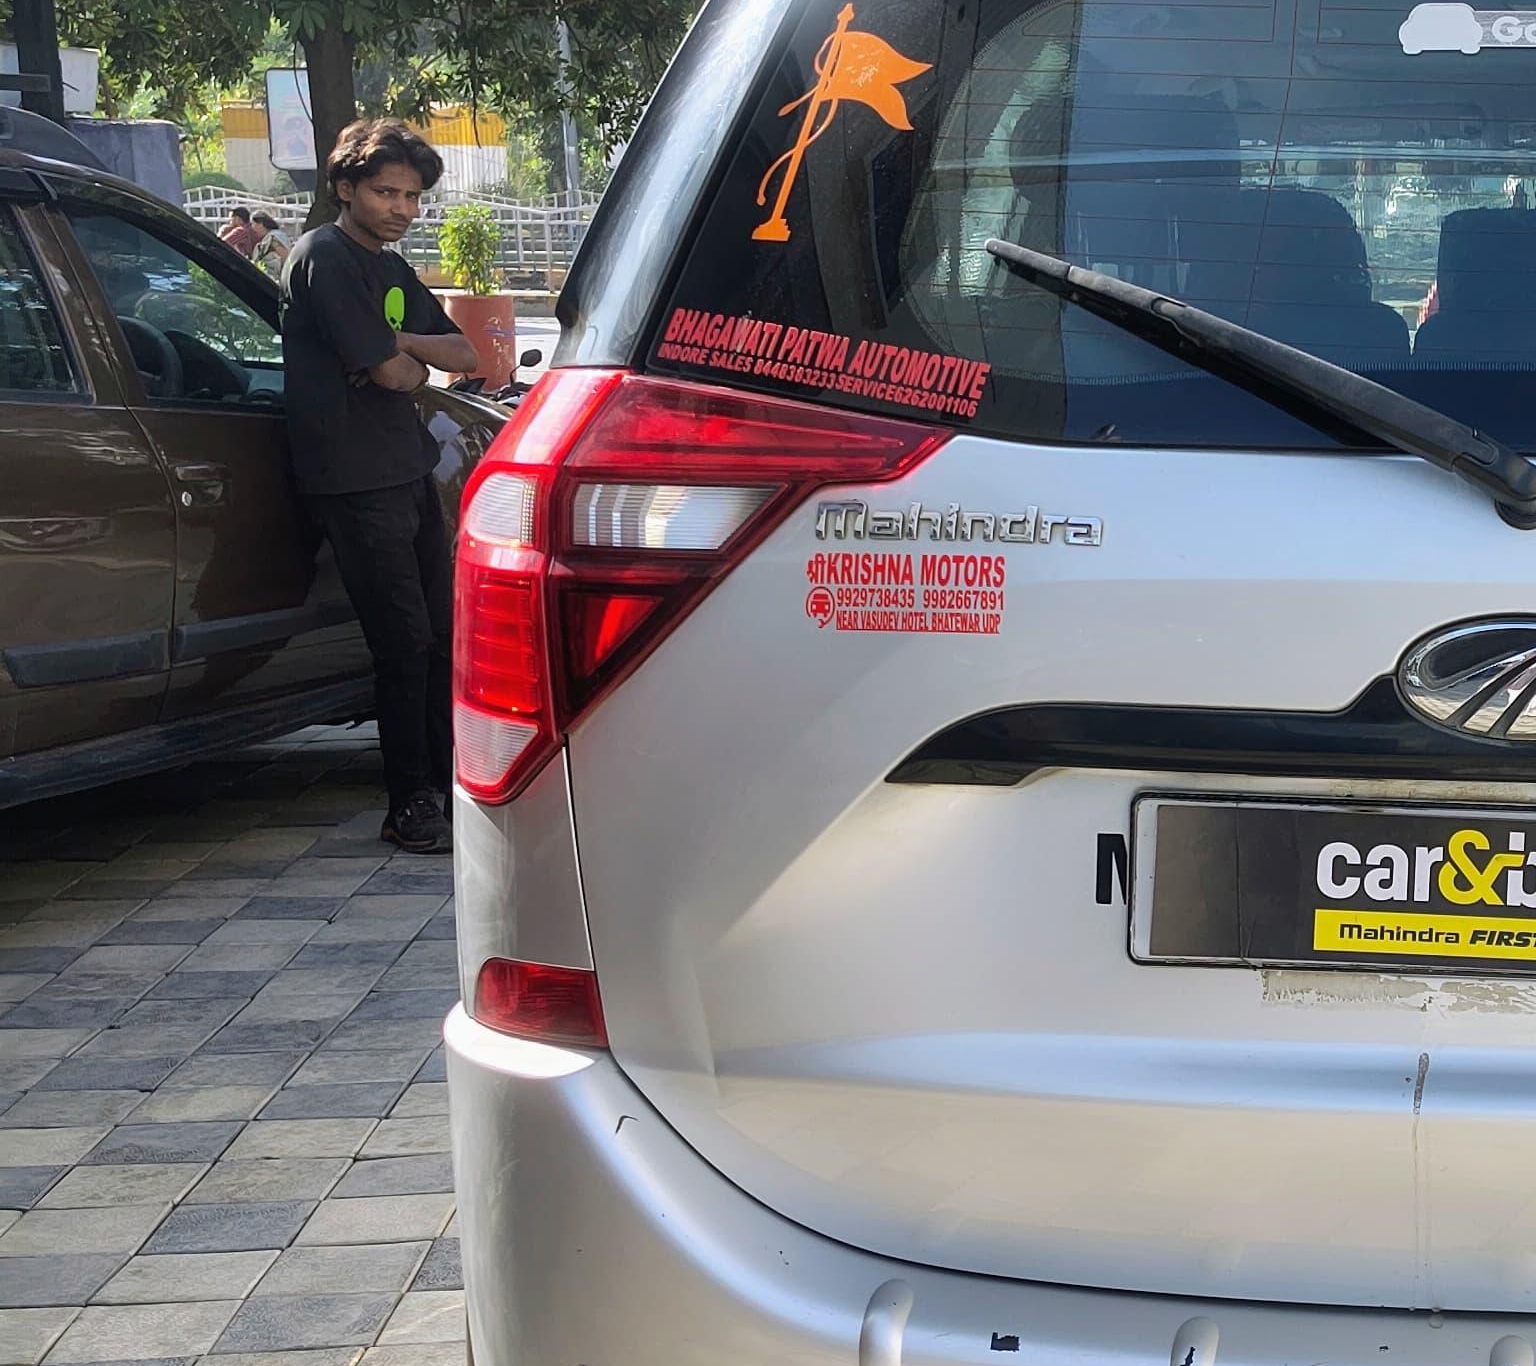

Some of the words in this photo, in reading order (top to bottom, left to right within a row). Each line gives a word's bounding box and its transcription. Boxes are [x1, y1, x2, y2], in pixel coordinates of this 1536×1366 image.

[658, 343, 708, 366] INDORE
[708, 350, 754, 373] SALES
[664, 308, 783, 355] BHAGAWATI
[777, 326, 850, 372] PATWA
[851, 340, 992, 400] AUTOMOTIVE
[816, 500, 1104, 547] Mahindra
[920, 554, 1005, 587] MOTORS
[836, 588, 915, 609] 9929738435
[923, 590, 1004, 611] 9982667891
[836, 611, 859, 631] NEAR
[901, 612, 929, 632] HOTEL
[1339, 923, 1460, 944] Mahindra
